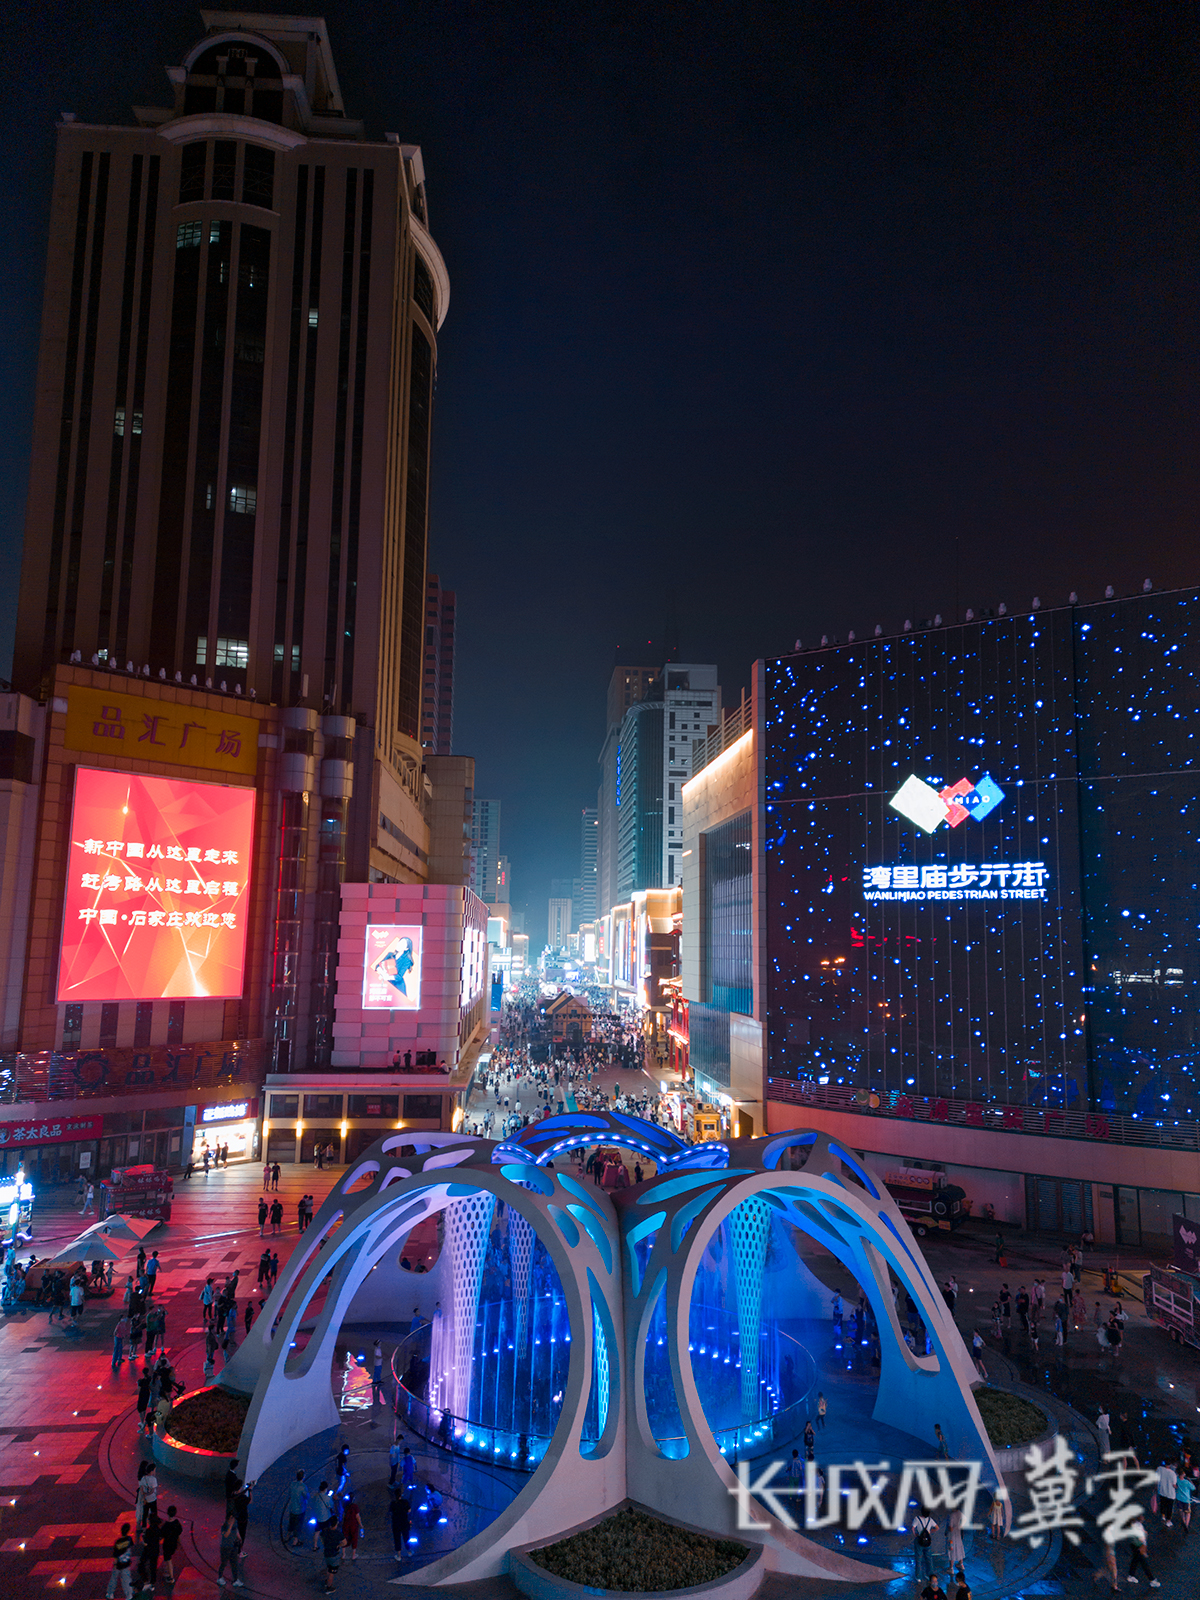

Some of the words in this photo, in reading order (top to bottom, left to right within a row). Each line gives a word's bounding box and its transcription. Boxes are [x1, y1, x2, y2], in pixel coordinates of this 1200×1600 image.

[93, 705, 242, 758] 品汇广场
[83, 838, 239, 865] 新中国从这里走来
[80, 872, 239, 897] 赶考路从这里启程
[863, 861, 1048, 889] 湾里庙步行街
[863, 890, 926, 901] WANLIMIAO
[927, 889, 998, 900] PEDESTRIAN
[1000, 888, 1047, 899] STREET
[12, 1123, 63, 1142] 茶太良品
